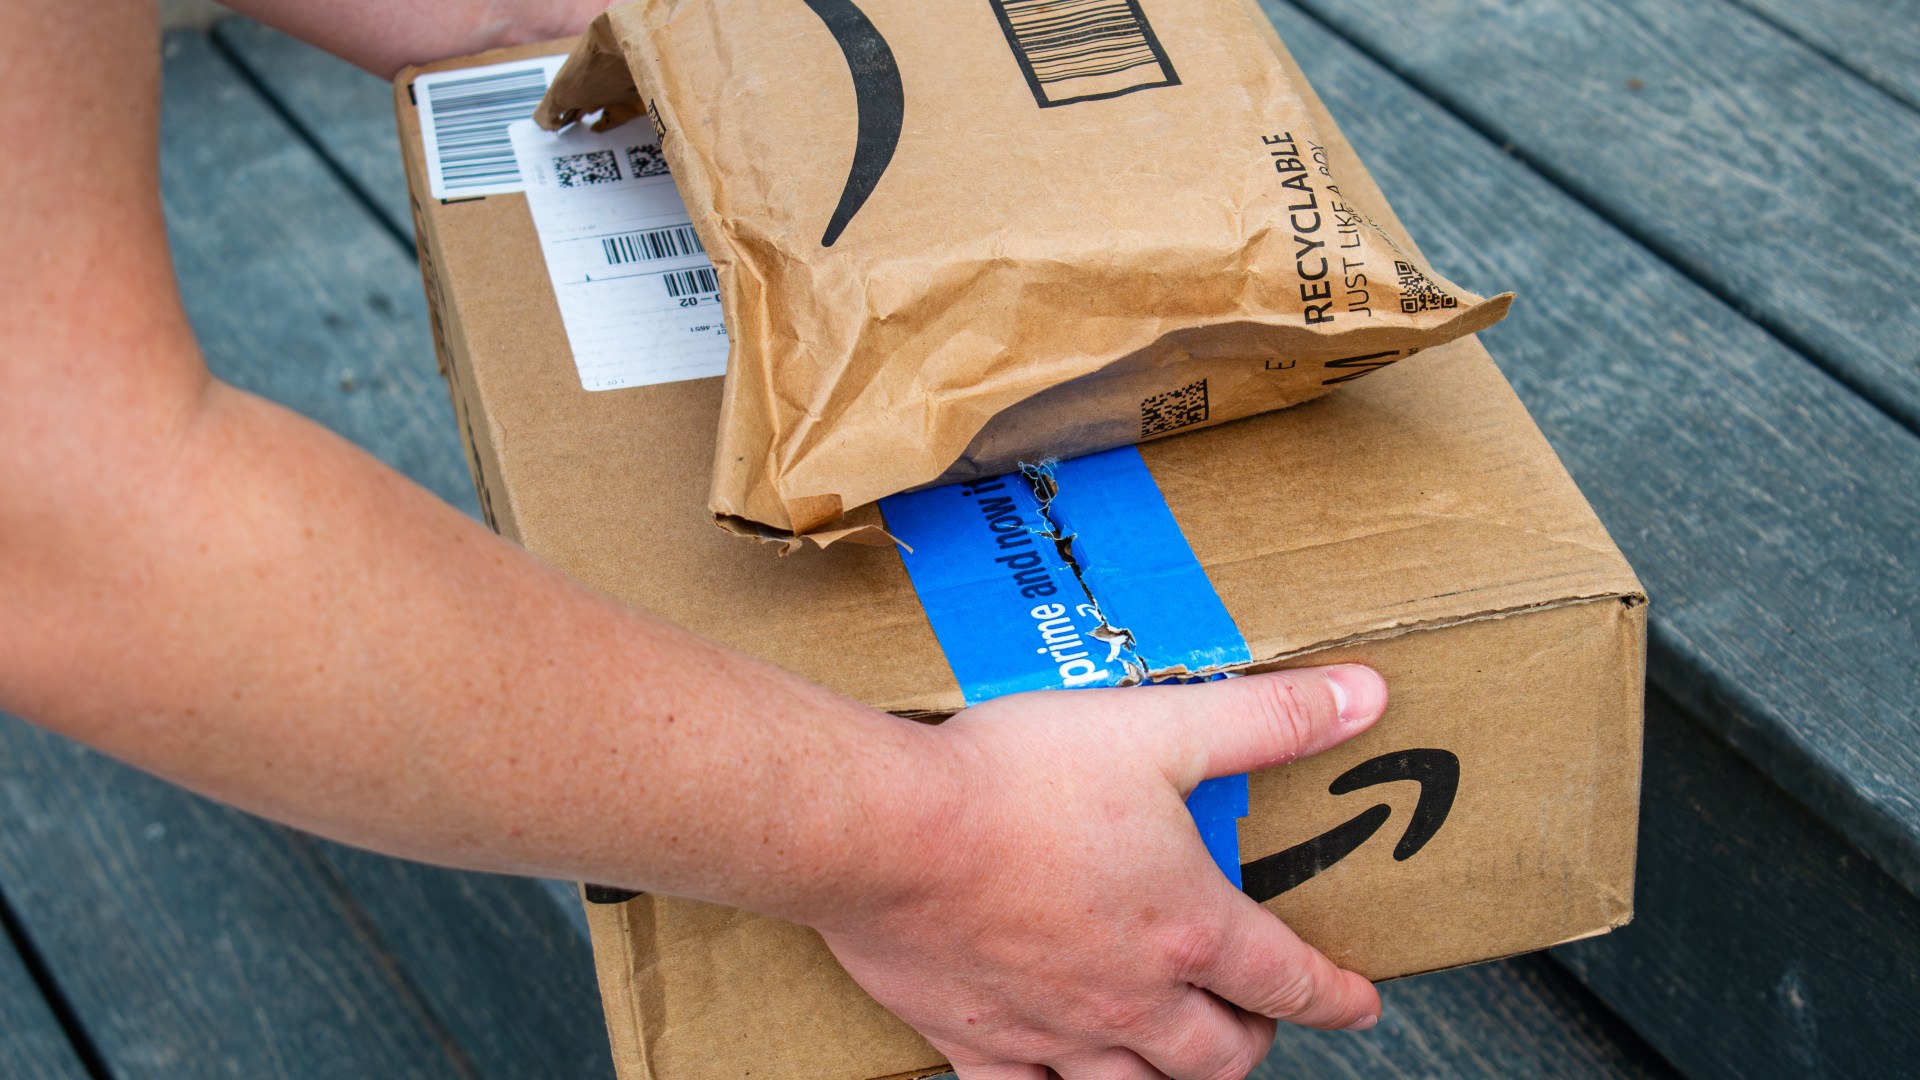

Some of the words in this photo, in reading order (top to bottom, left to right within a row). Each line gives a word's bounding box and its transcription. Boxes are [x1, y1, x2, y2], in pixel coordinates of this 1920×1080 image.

[1261, 131, 1335, 325] RECYCLABLE
[1331, 200, 1361, 249] LIKE
[1342, 257, 1372, 318] JUST
[977, 496, 1033, 550] now
[994, 549, 1057, 599] and
[1030, 602, 1109, 687] prime
